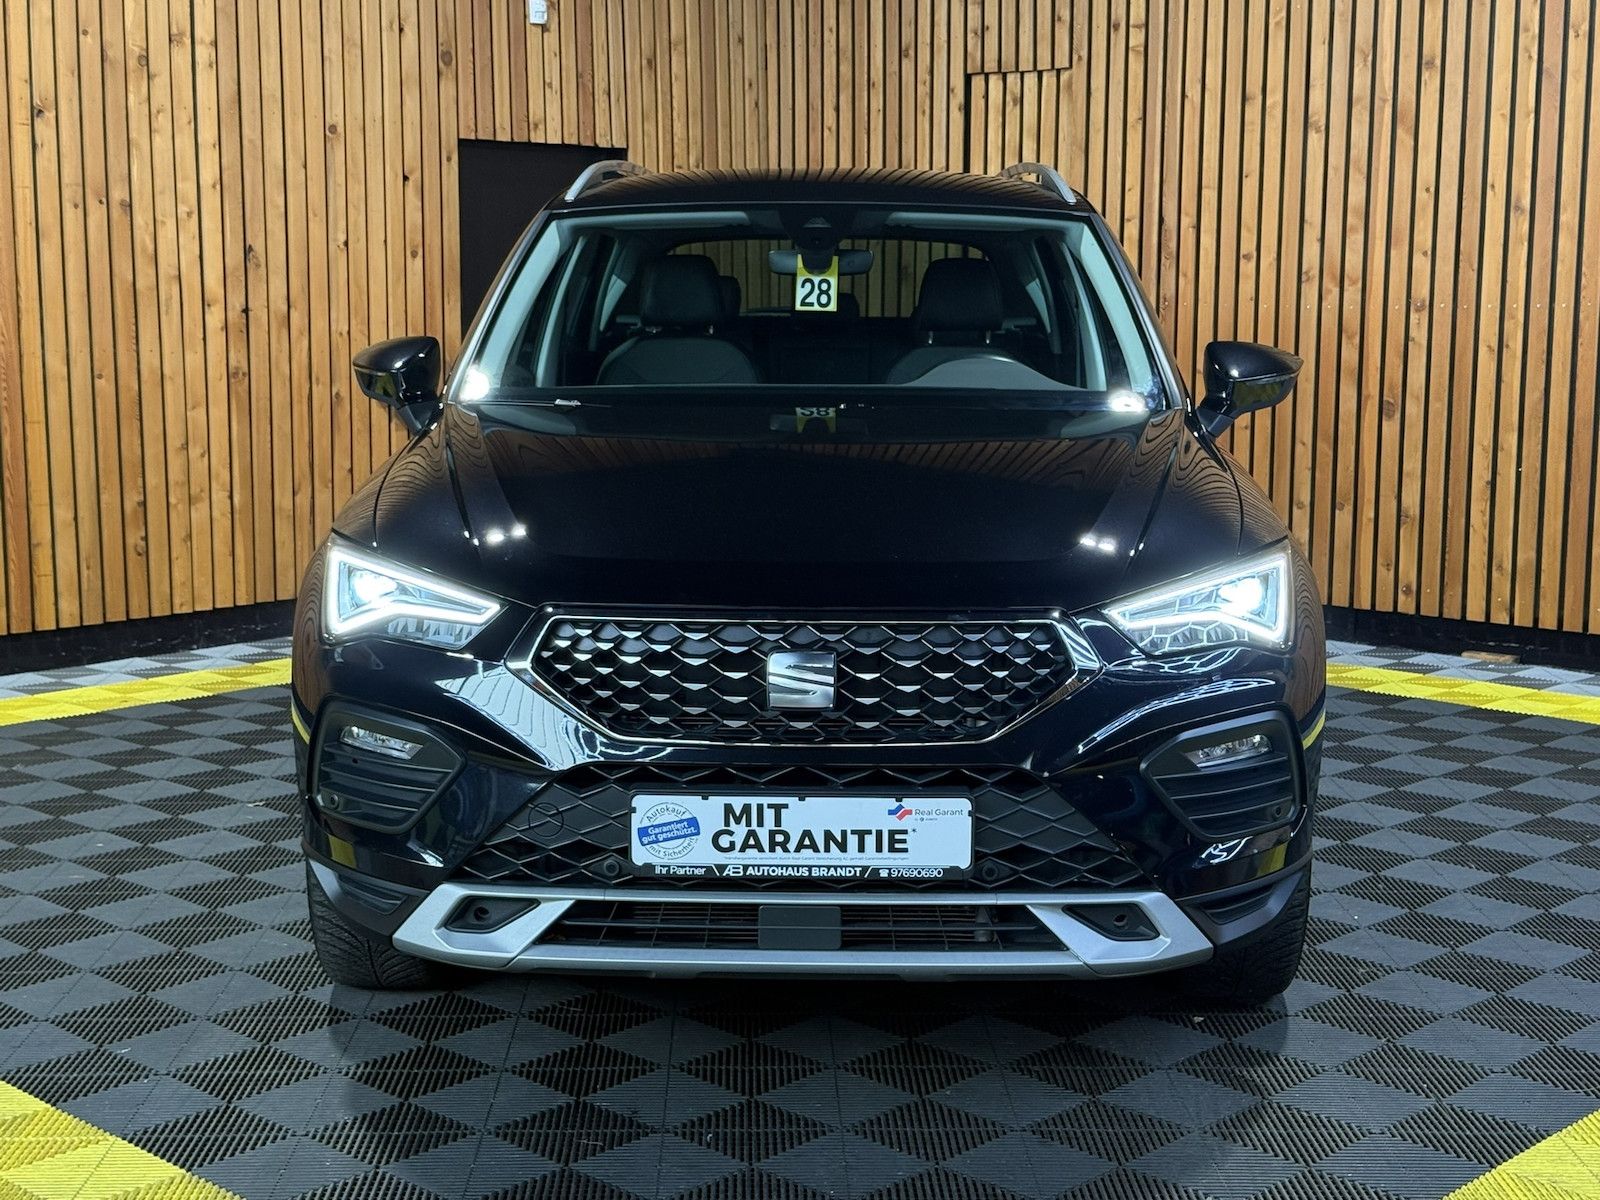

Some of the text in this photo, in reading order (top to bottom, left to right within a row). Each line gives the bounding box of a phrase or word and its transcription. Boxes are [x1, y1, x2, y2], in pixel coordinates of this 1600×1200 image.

[799, 277, 832, 308] 28
[646, 804, 688, 823] Autokauf
[723, 803, 789, 828] MIT
[914, 808, 964, 816] Real Garant
[647, 820, 689, 835] Garantiert
[641, 832, 658, 845] gut
[648, 836, 699, 858] mit Sicherheit
[654, 865, 667, 875] Ihr
[669, 865, 707, 876] Partner
[745, 866, 809, 876] AUTOHAUS
[810, 866, 862, 877] BRANDT
[890, 868, 944, 878] 97690690
